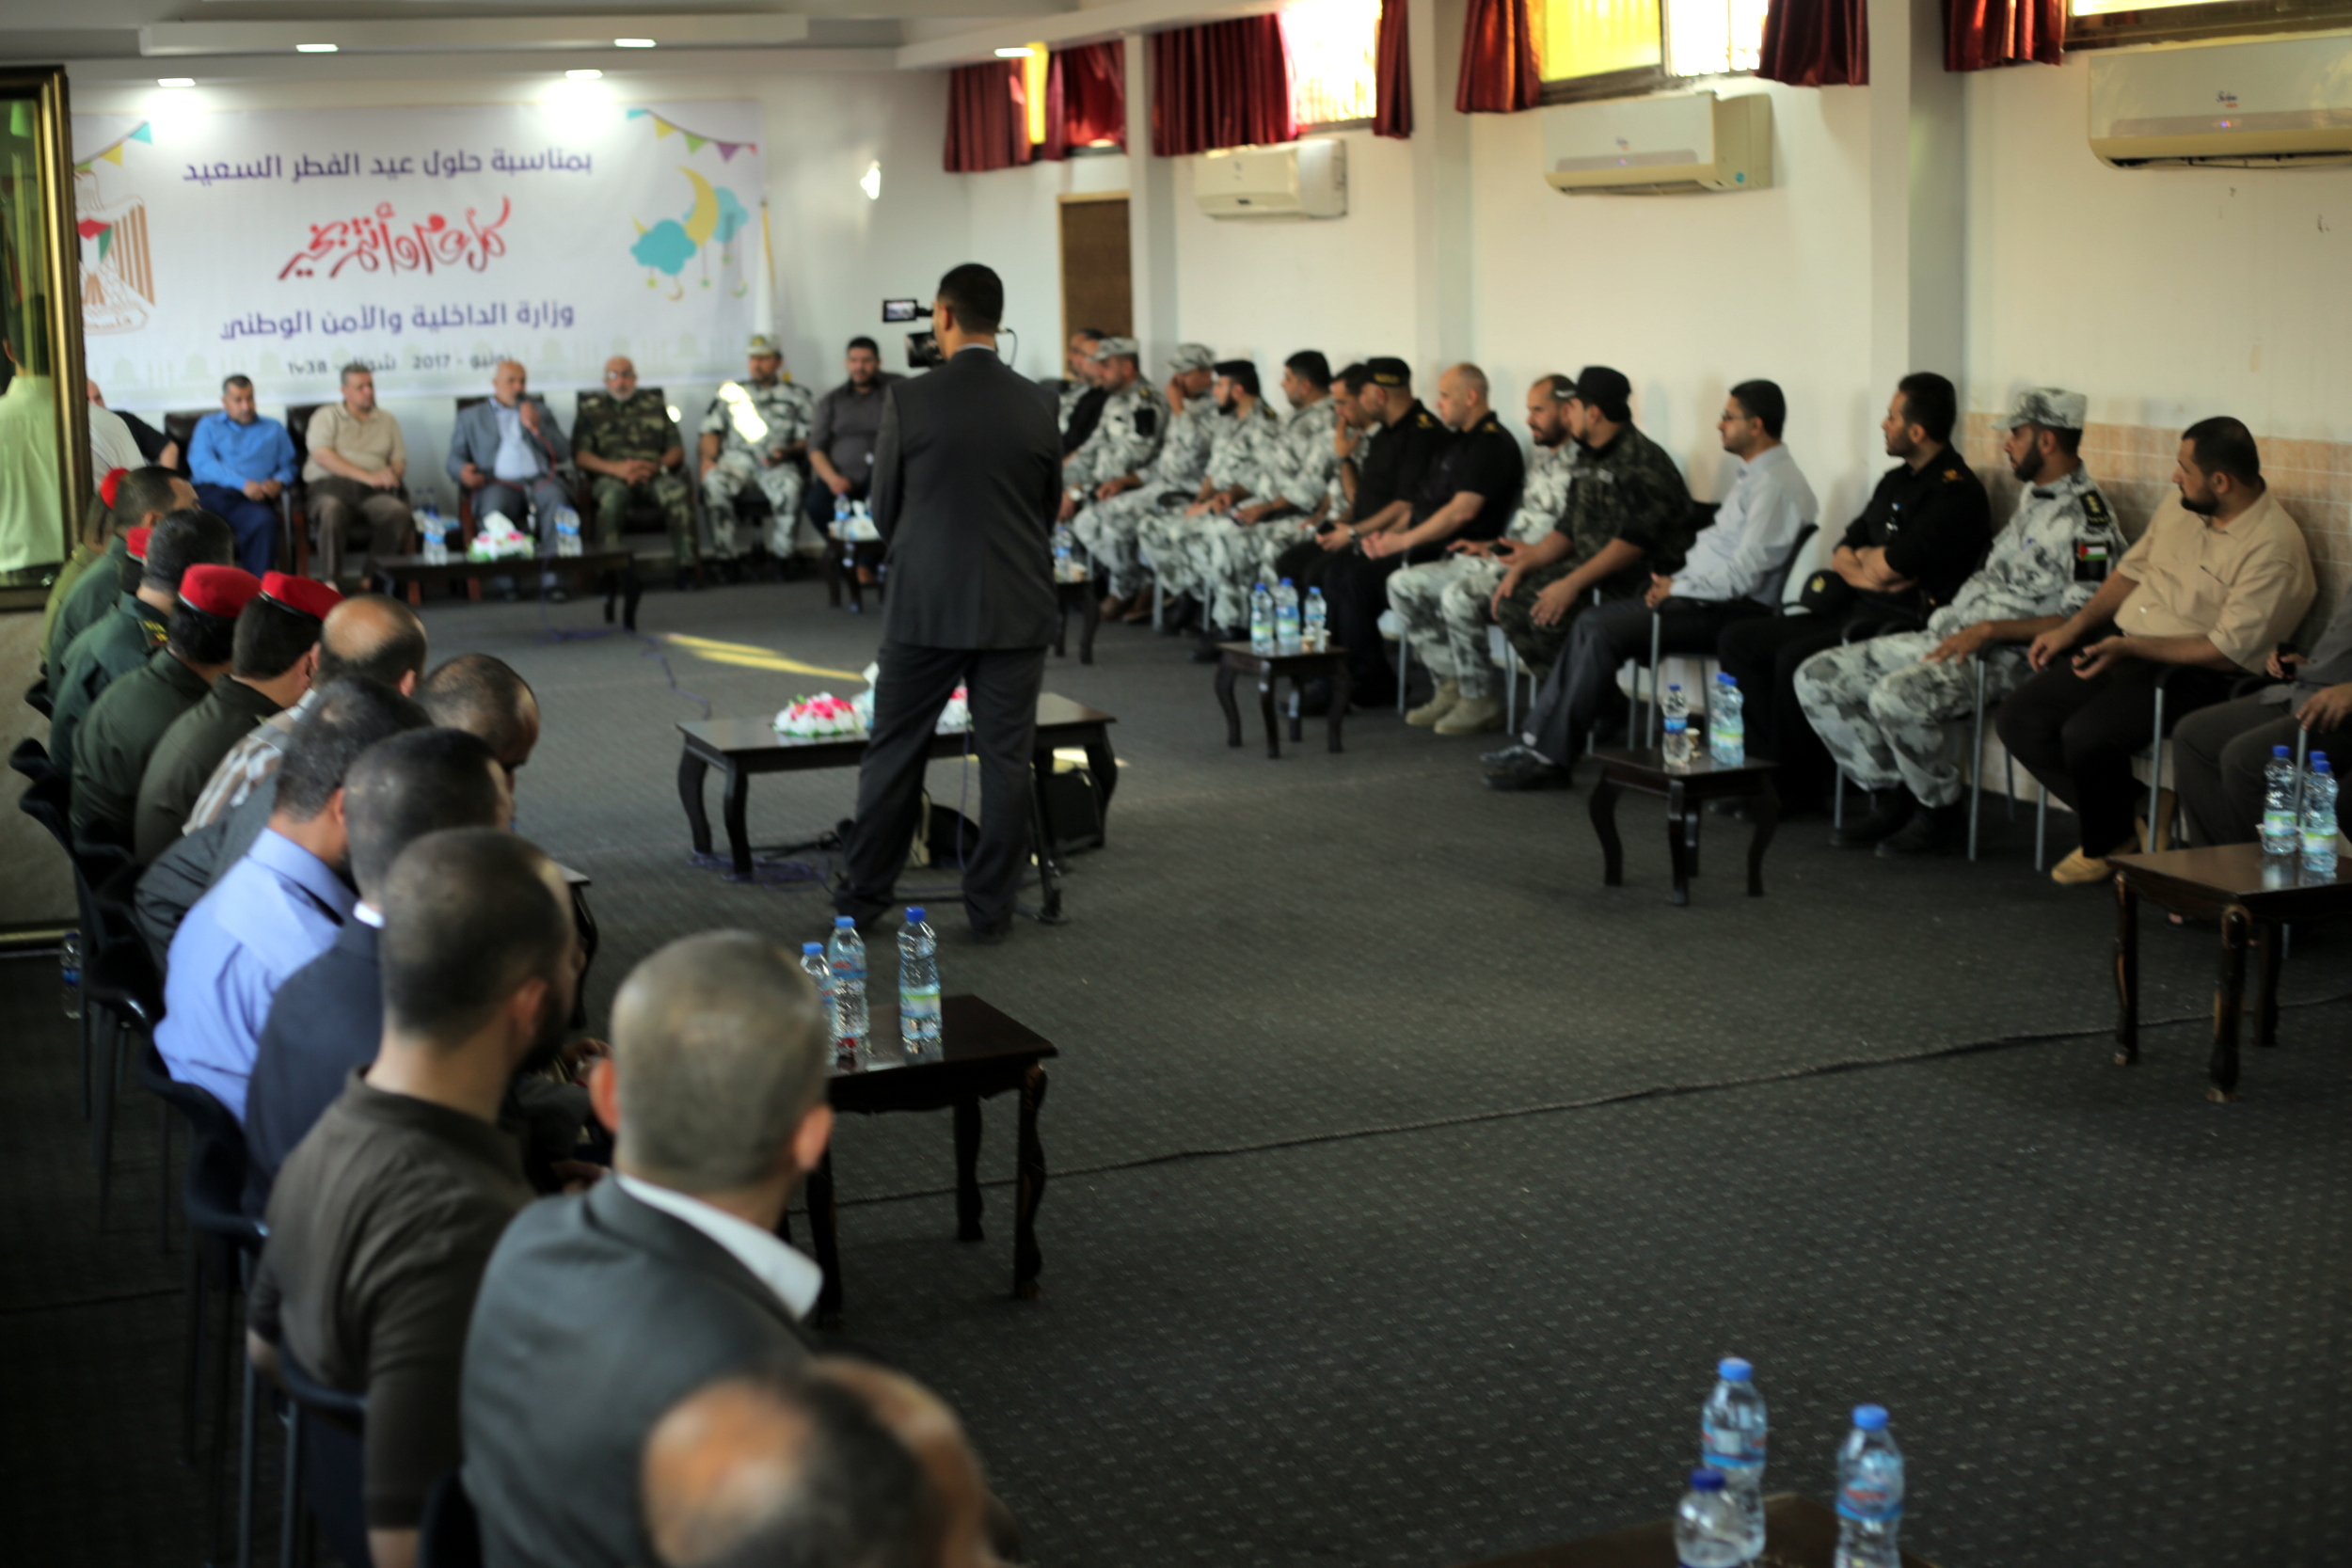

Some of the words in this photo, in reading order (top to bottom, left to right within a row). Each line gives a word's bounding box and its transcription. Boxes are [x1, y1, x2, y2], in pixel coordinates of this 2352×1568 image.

[183, 153, 282, 187] السعيد
[291, 151, 360, 184] الفطر
[370, 153, 415, 182] عيد
[422, 149, 483, 180] حلول
[490, 147, 592, 178] بمناسبة
[278, 219, 349, 281] بخير
[465, 194, 512, 274] كل
[219, 309, 312, 341] الوطني
[321, 302, 404, 336] والأمن
[411, 301, 508, 334] الداخلية
[516, 299, 575, 330] وزارة
[412, 353, 452, 371] 2017
